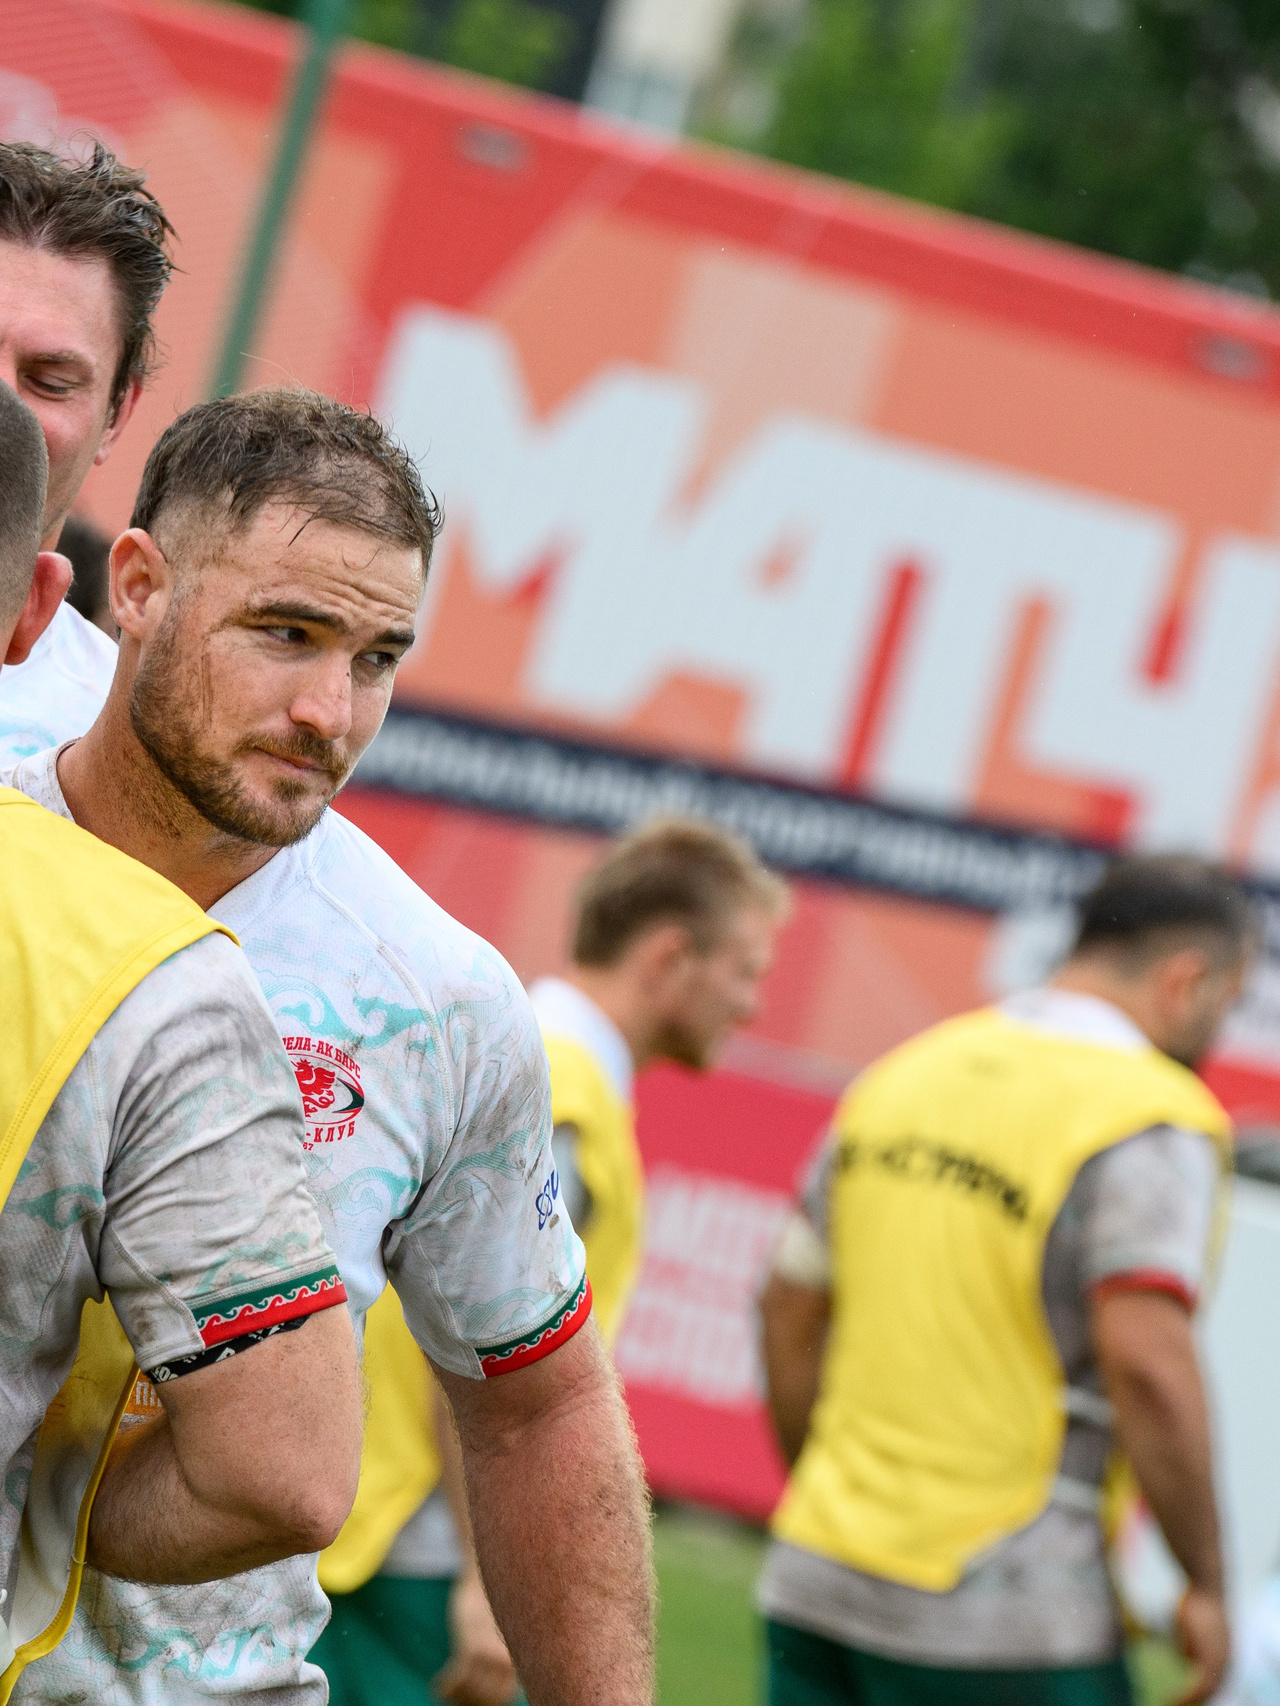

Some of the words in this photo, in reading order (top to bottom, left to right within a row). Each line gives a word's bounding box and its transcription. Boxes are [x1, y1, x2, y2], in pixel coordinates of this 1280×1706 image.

[372, 302, 1280, 872] МАТЧ
[282, 1036, 333, 1059] ЕЛА-АК
[335, 1048, 361, 1080] БАРС
